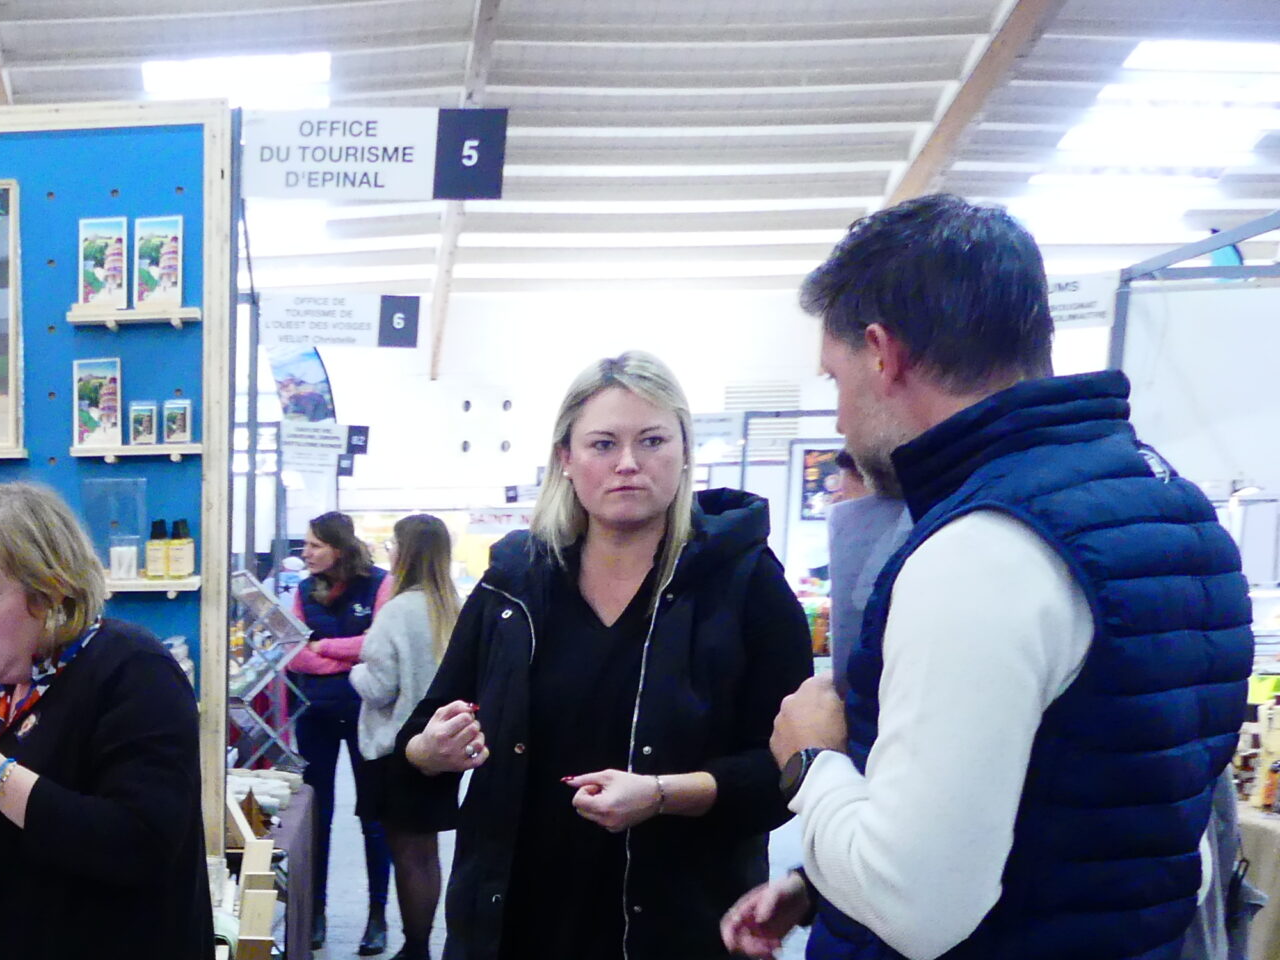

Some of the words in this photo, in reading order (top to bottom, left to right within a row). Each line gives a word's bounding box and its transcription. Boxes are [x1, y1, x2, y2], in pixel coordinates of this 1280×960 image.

[298, 120, 379, 137] OFFICE
[259, 146, 290, 163] DU
[298, 146, 415, 163] TOURISME
[461, 140, 480, 166] 5
[285, 171, 386, 188] D'EPINAL
[293, 297, 330, 306] OFFICE
[332, 298, 345, 306] DE
[284, 309, 336, 318] TOURISME
[339, 310, 353, 319] DE
[392, 313, 406, 329] 6
